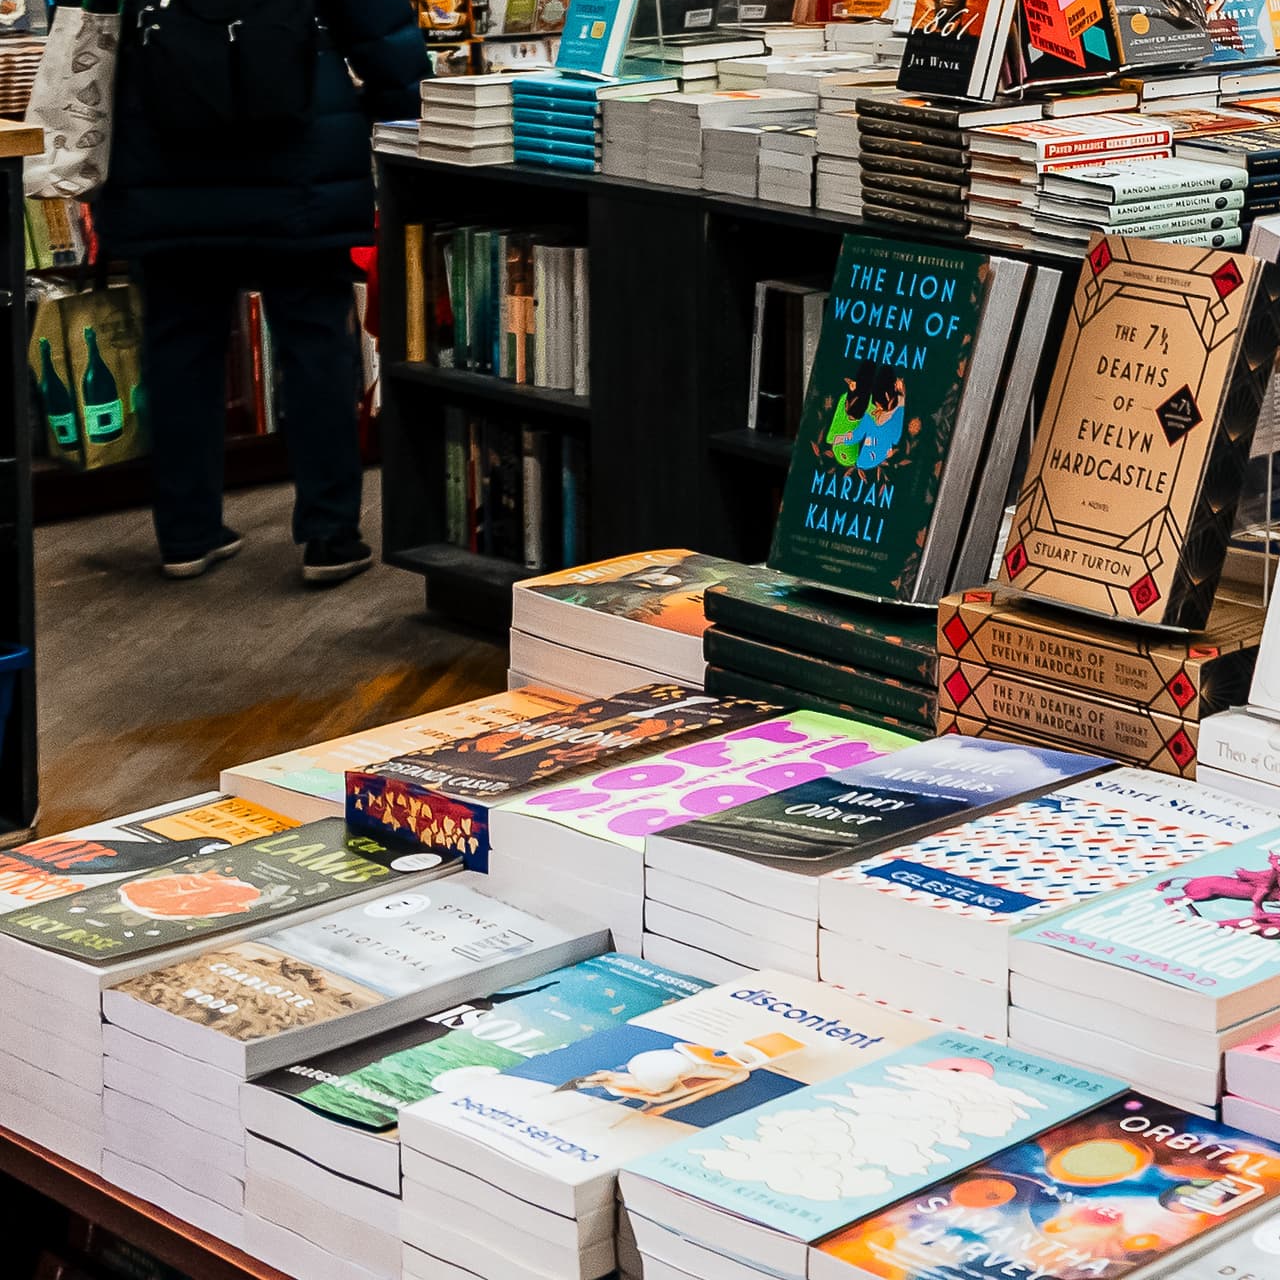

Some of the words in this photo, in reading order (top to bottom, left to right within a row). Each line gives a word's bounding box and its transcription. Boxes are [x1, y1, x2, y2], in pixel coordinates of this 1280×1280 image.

[911, 7, 980, 41] 1861
[849, 263, 886, 291] THE
[894, 271, 958, 304] LION
[833, 299, 912, 333] WOMEN
[925, 314, 961, 339] OF
[1113, 323, 1137, 343] THE
[842, 333, 929, 371] TEHRAN
[1095, 355, 1170, 389] DEATHS
[1111, 395, 1135, 413] OF
[1076, 418, 1155, 455] EVELYN
[1048, 448, 1168, 495] HARDCASTLE
[810, 471, 895, 511] MARJAN
[803, 502, 886, 545] KAMALI
[1032, 541, 1077, 567] STUART
[1081, 552, 1133, 578] TURTON
[785, 801, 885, 826] Oliver
[831, 789, 916, 813] Mary
[253, 832, 392, 885] LAMB
[399, 918, 450, 946] YARD
[438, 902, 499, 934] STONE
[320, 921, 434, 976] DEVOTIONAL
[182, 987, 241, 1016] WOOD
[207, 960, 314, 1011] CHARLOTTE
[728, 985, 888, 1054] discontent
[1118, 1115, 1277, 1179] ORBITAL
